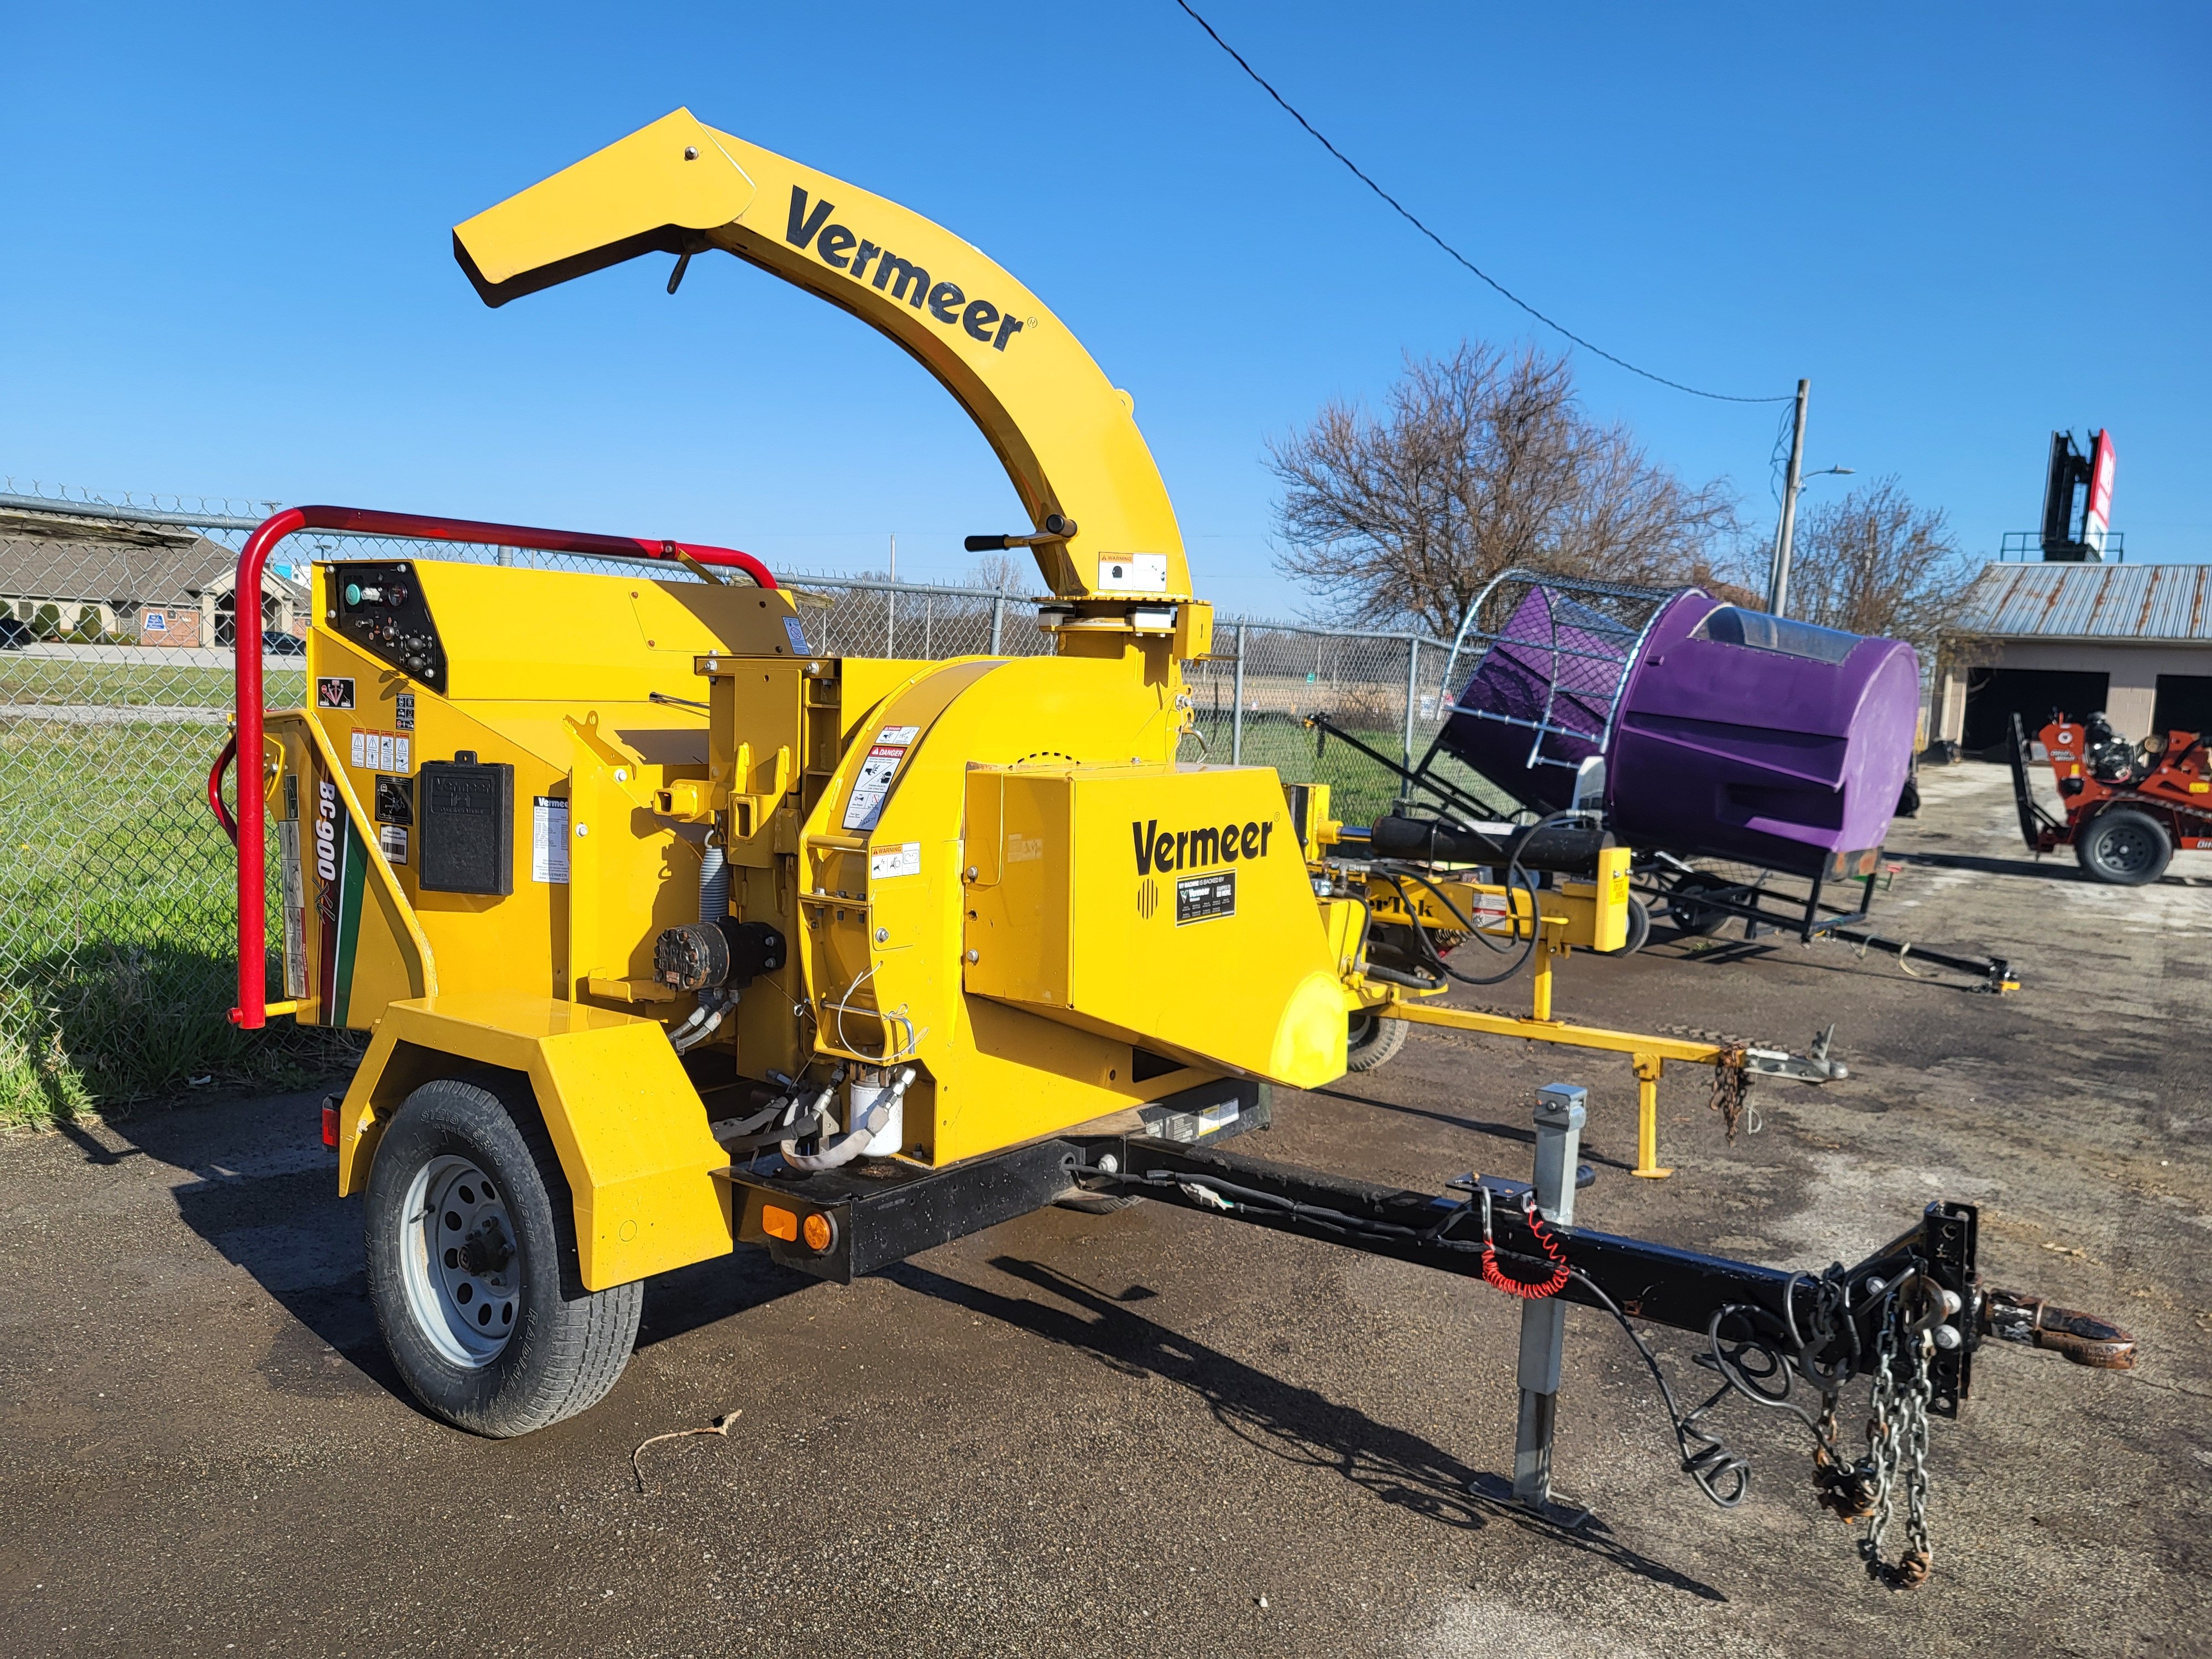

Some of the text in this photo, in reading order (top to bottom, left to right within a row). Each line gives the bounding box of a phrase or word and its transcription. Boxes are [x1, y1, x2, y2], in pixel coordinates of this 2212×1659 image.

[786, 184, 1024, 352] Vermeer
[316, 781, 336, 881] BC900
[538, 797, 568, 808] Vermee
[1132, 819, 1273, 876] Vermeer
[1189, 887, 1210, 897] Vermeer
[507, 1307, 539, 1391] RADIAL
